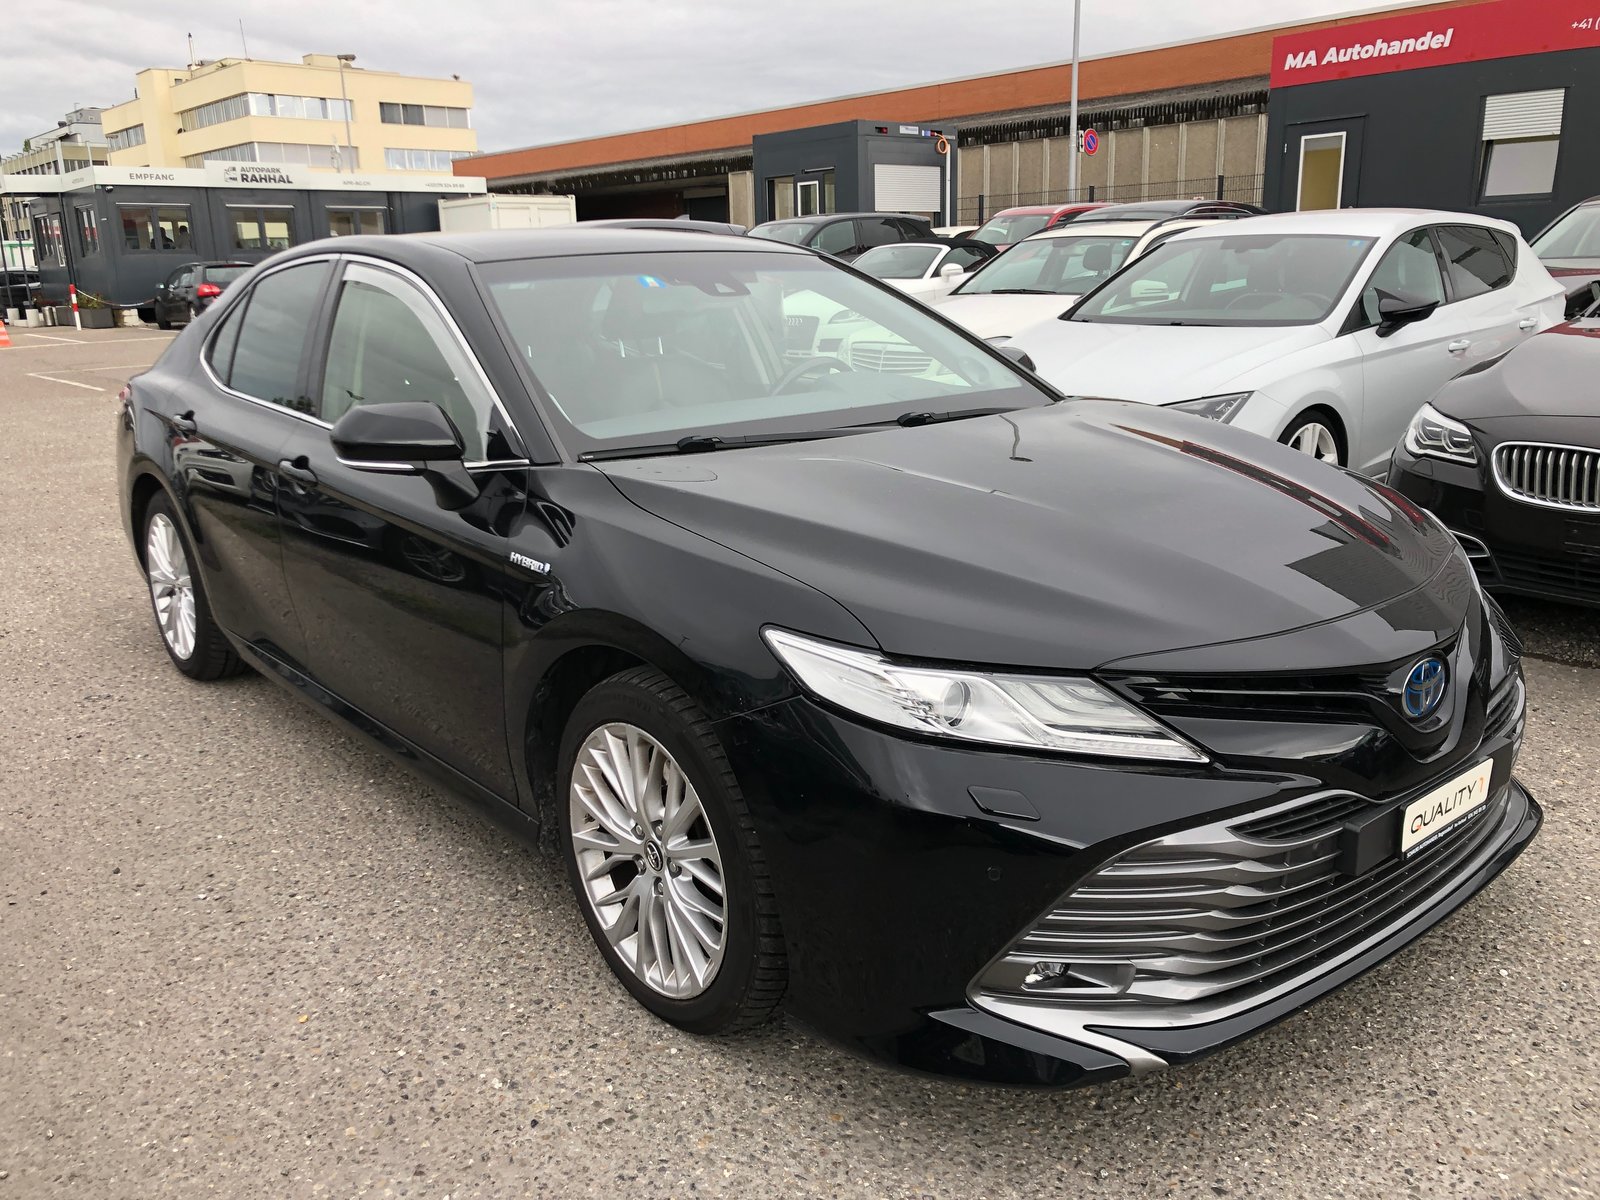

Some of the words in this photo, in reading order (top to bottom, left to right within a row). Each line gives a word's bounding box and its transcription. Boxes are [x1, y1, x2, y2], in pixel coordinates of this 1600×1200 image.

[1571, 17, 1593, 29] +41
[1284, 50, 1317, 70] MA
[1321, 28, 1454, 65] Autohandel
[240, 166, 281, 174] AUTOPARK
[129, 172, 175, 181] EMPFANG
[240, 173, 293, 184] RAHHAL
[510, 551, 544, 574] HYBRID
